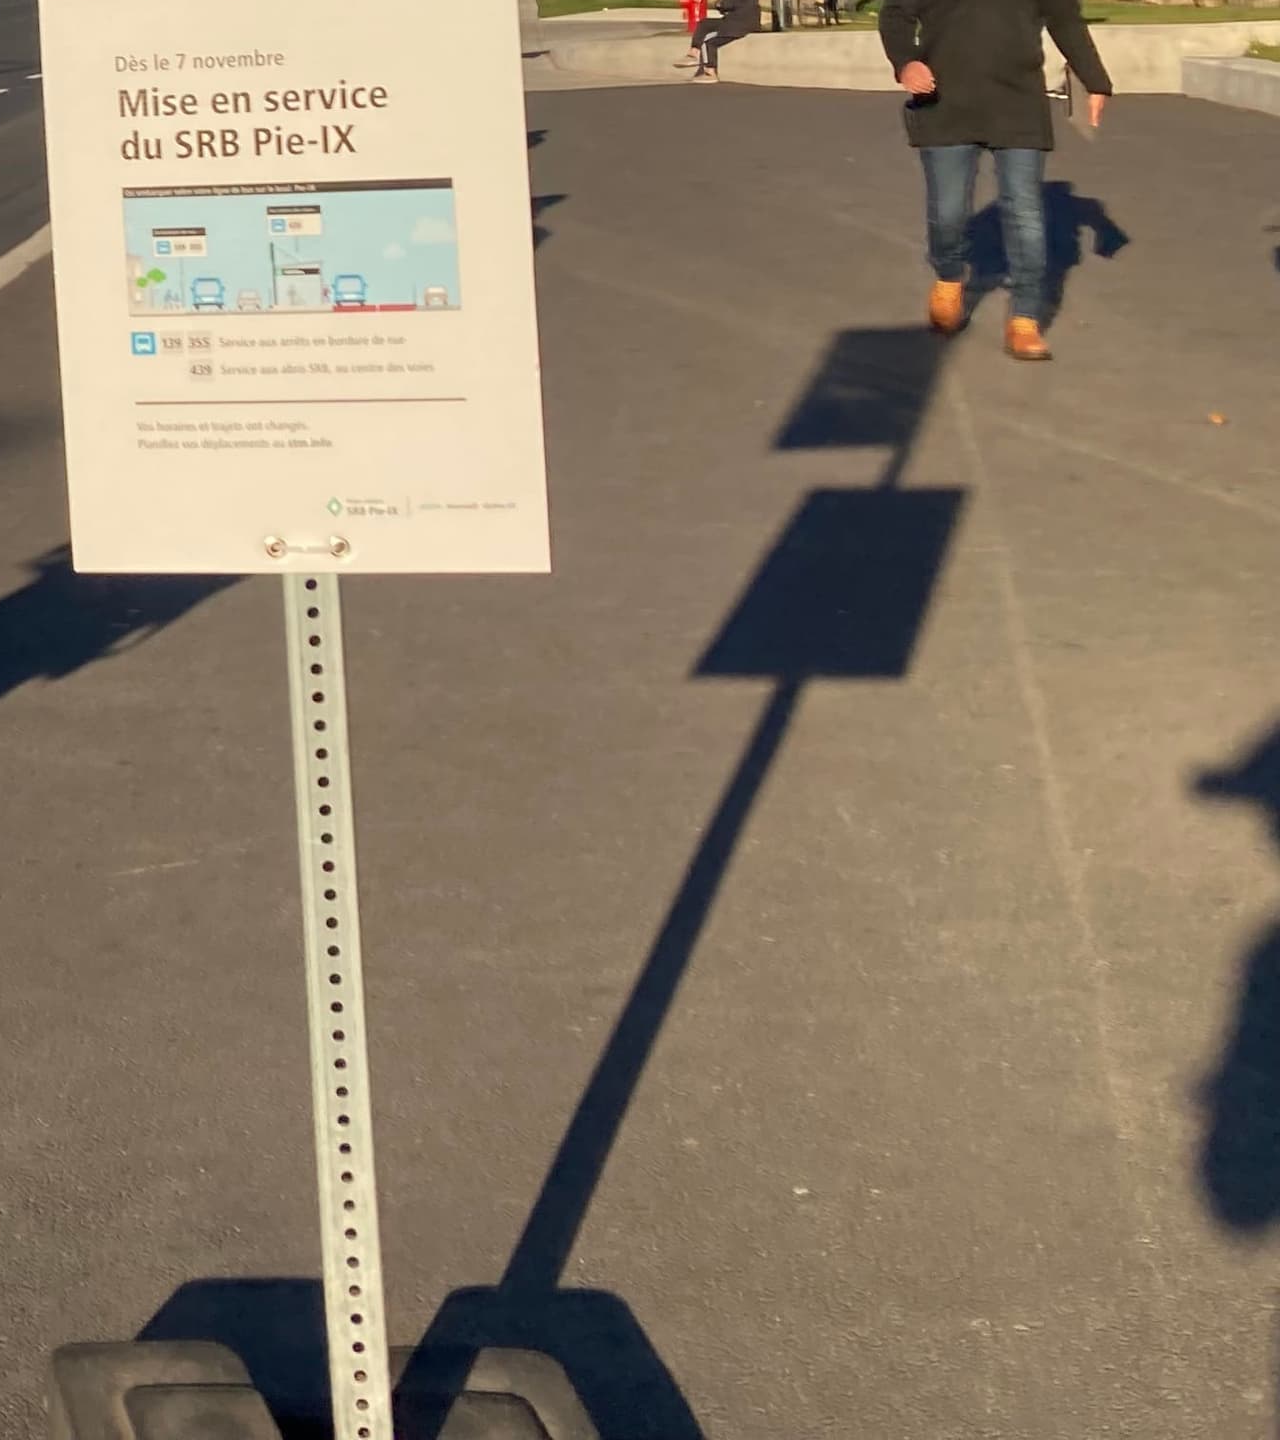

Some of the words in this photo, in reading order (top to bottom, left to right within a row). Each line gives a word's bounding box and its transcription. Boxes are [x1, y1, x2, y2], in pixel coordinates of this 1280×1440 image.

[114, 53, 148, 73] Dès
[153, 54, 170, 72] le
[176, 53, 186, 71] 7
[192, 49, 285, 69] novembre
[117, 86, 198, 118] Mise
[211, 90, 252, 114] en
[264, 79, 389, 113] service
[120, 128, 162, 161] du
[174, 127, 241, 159] SRB
[253, 123, 357, 157] Pie-IX
